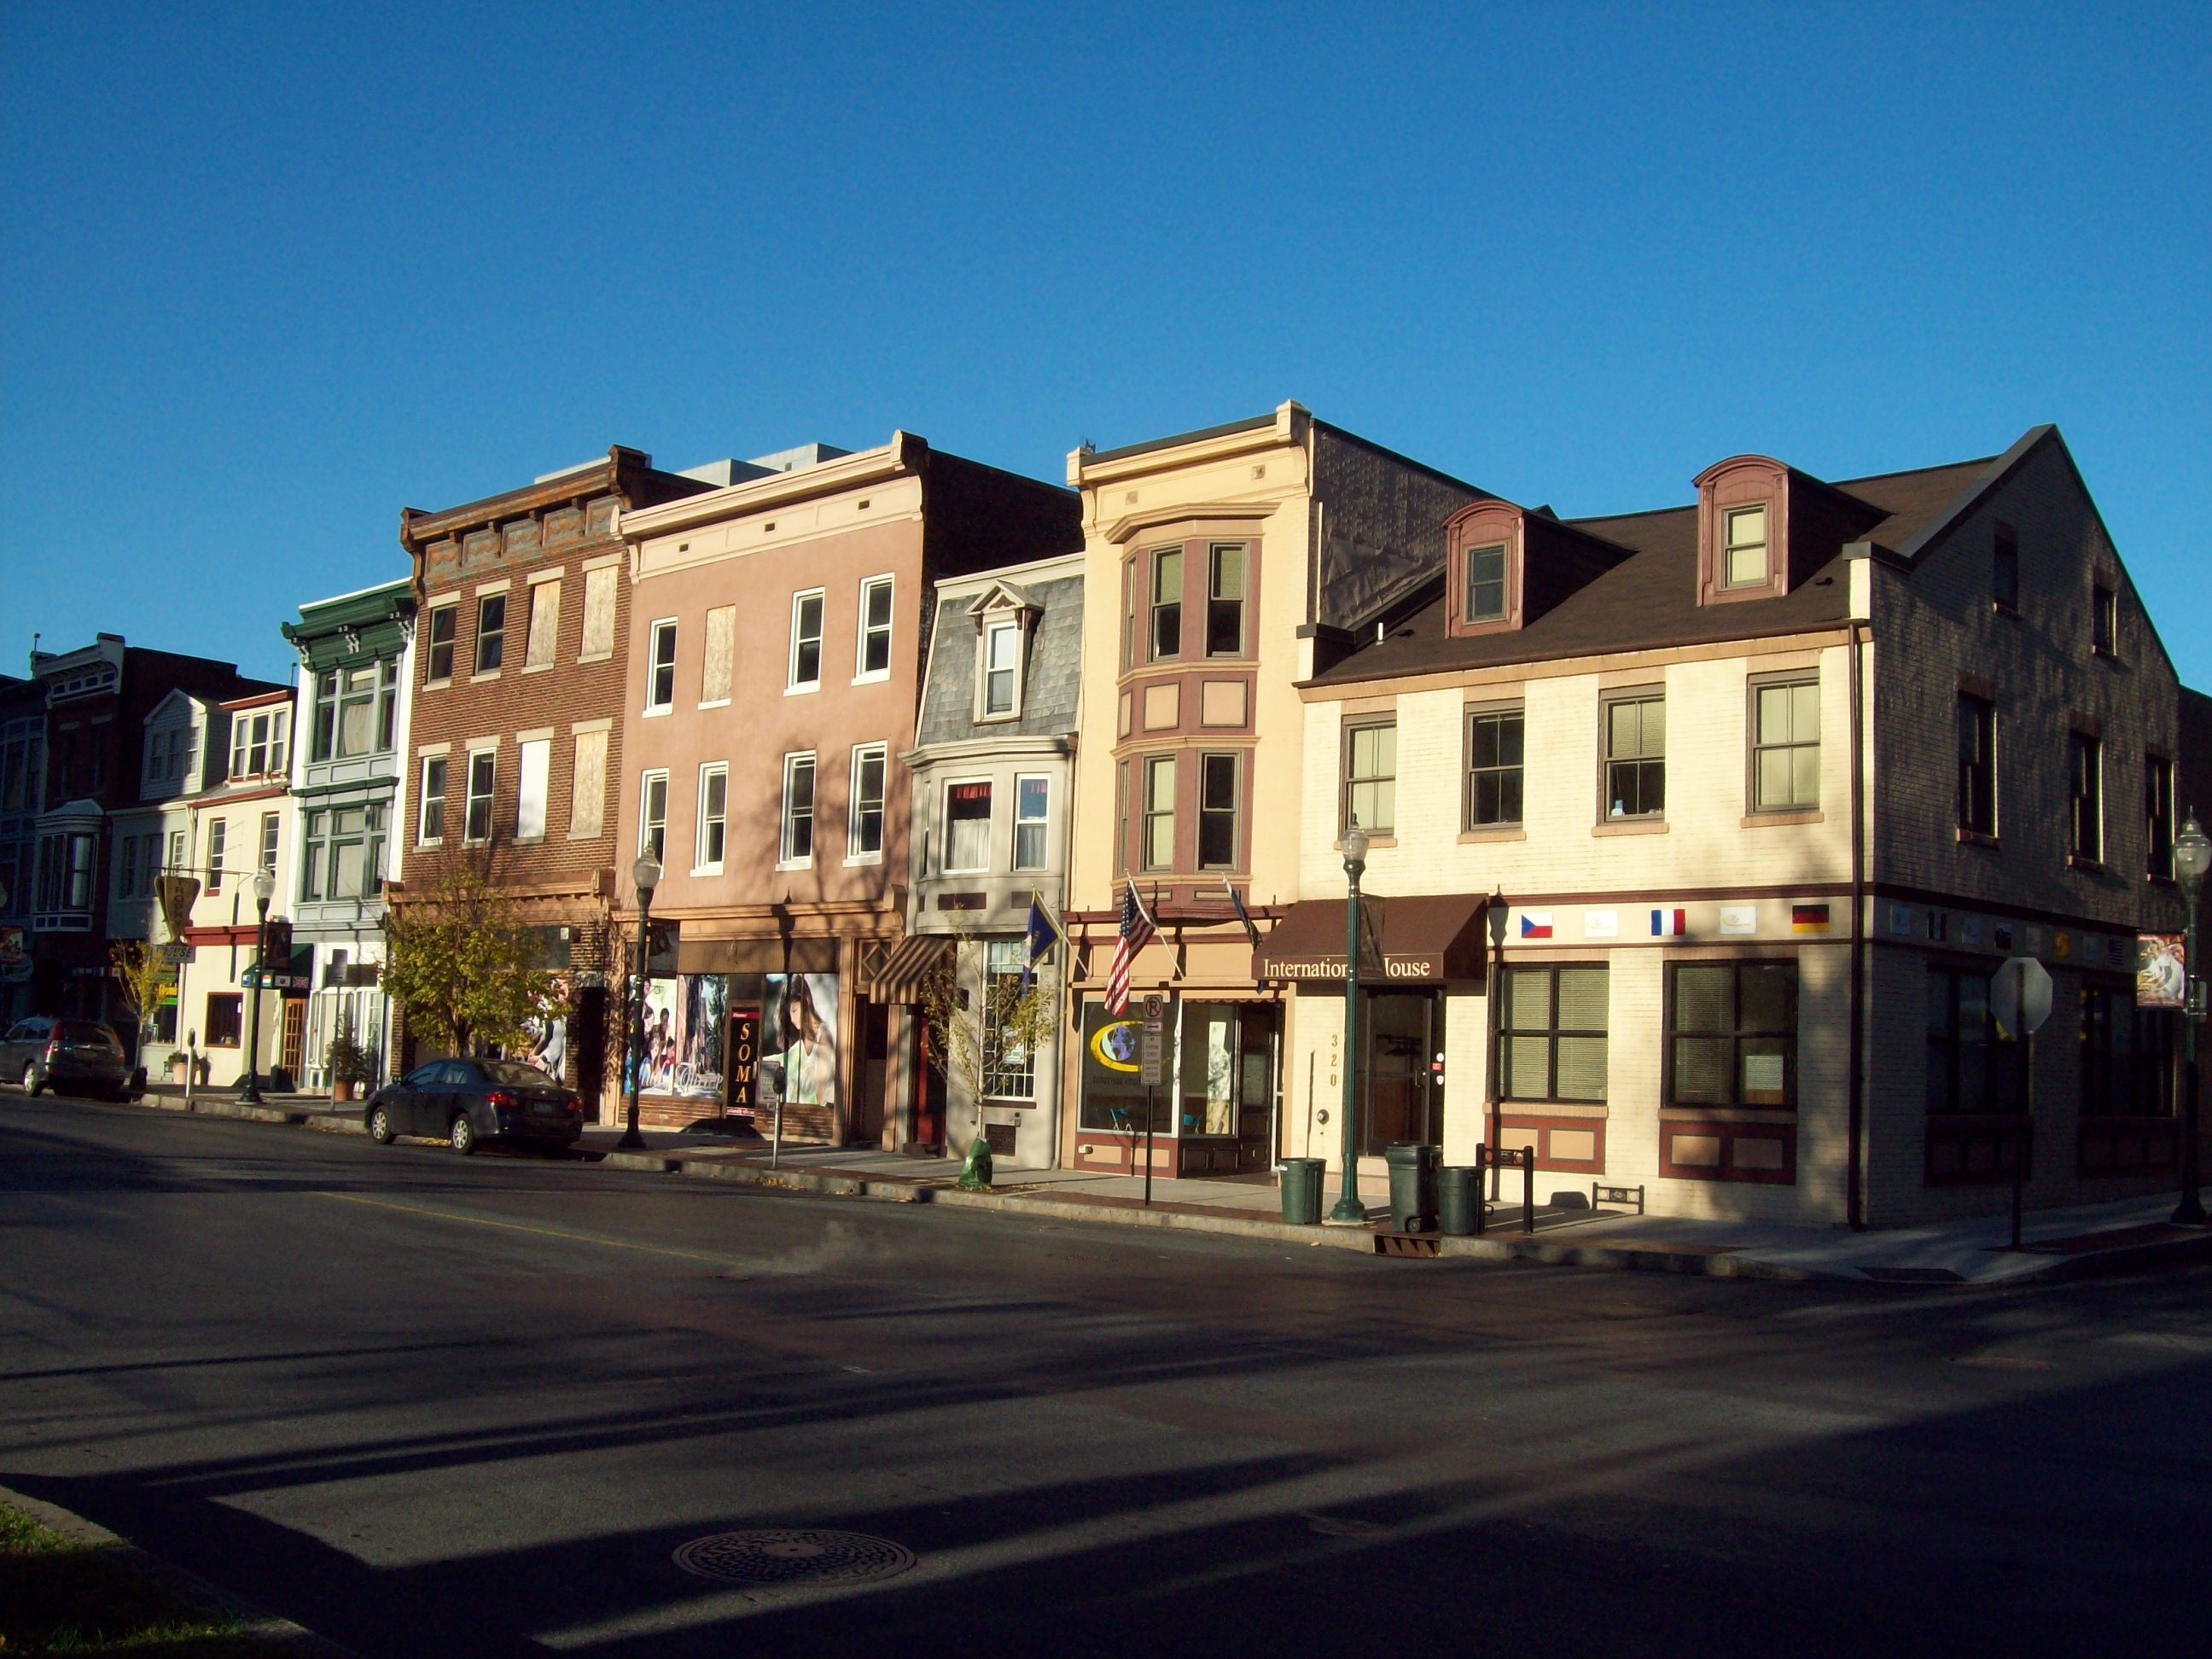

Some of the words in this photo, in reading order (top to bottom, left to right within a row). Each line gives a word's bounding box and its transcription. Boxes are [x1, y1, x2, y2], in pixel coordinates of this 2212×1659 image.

[1264, 958, 1348, 977] Internation
[736, 1022, 751, 1103] SOMA
[1330, 1033, 1338, 1086] 320
